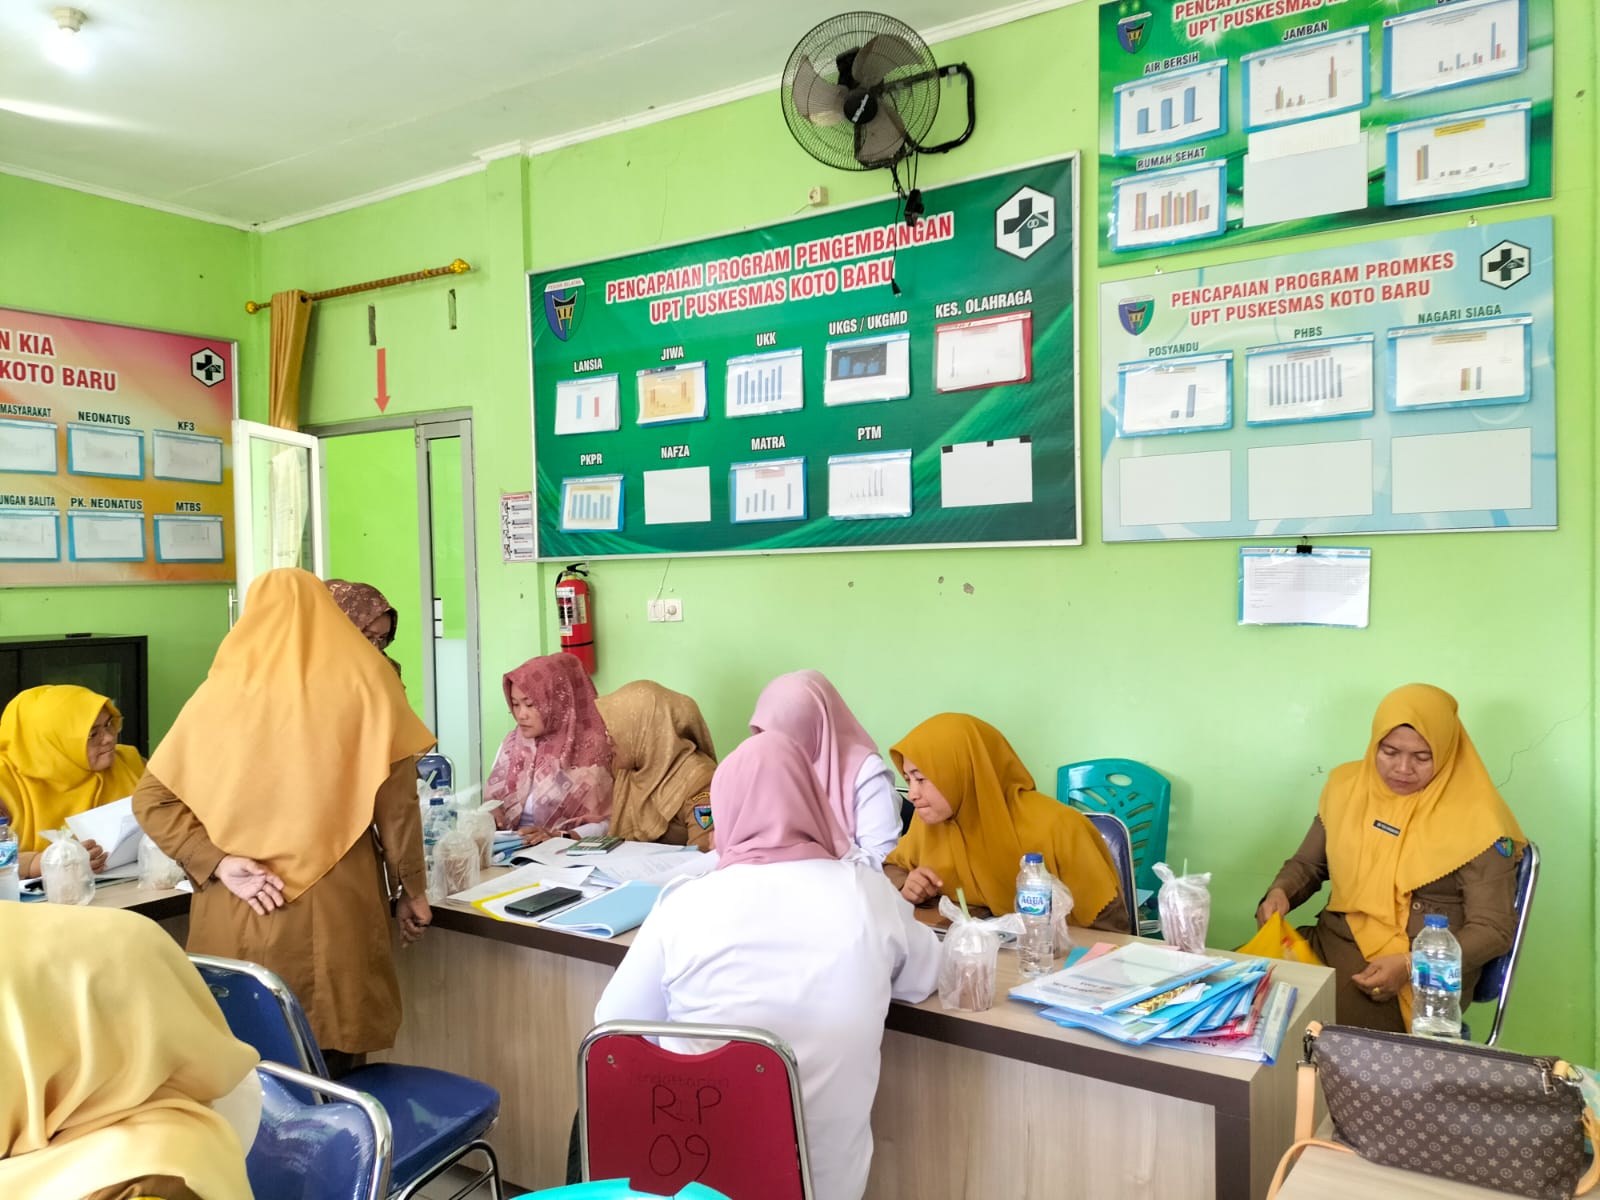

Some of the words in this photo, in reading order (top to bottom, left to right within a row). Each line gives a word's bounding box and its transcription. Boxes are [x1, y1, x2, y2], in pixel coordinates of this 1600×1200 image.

[1189, 17, 1217, 38] UPT
[1283, 21, 1328, 41] JAMBAN
[1144, 61, 1161, 74] AIR
[1163, 53, 1199, 70] BERSIH
[1137, 154, 1173, 170] RUMAH
[1175, 147, 1206, 162] SEHAT
[607, 266, 702, 303] PENCAPAIAN
[707, 248, 790, 284] PROGRAM
[796, 214, 954, 267] PENGEMBANGAN
[1171, 279, 1269, 308] PENCAPAIAN
[1275, 266, 1359, 293] PROGRAM
[1365, 252, 1455, 280] PROMKES
[651, 299, 682, 323] UPT
[685, 280, 786, 317] PUSKESMAS
[791, 270, 837, 299] KOTO
[843, 258, 894, 289] BARU
[935, 304, 962, 319] KES.
[965, 289, 1033, 313] OLAHRAGA
[1191, 308, 1221, 326] UPT
[1226, 294, 1324, 321] PUSKESMAS
[1330, 287, 1375, 307] KOTO
[1381, 279, 1430, 301] BARU
[1418, 309, 1462, 324] NAGARI
[1465, 304, 1502, 318] SIAGA
[828, 318, 857, 335] UKGS
[859, 316, 865, 332] /
[867, 310, 908, 329] UKGMD
[756, 331, 777, 347] UKK
[1294, 326, 1323, 339] PHBS
[19, 333, 54, 356] KIA
[1148, 341, 1199, 357] POSYANDU
[661, 346, 684, 361] JIWA
[573, 358, 603, 373] LANSIA
[0, 360, 54, 384] KOTO
[62, 367, 116, 391] BARU
[78, 411, 131, 425] NEONATUS
[177, 421, 195, 432] KF3
[857, 426, 882, 441] PTM
[751, 436, 785, 451] MATRA
[580, 453, 603, 466] PKPR
[660, 445, 690, 459] NAFZA
[28, 496, 56, 507] BALITA
[70, 497, 87, 508] PK.
[90, 498, 143, 510] NEONATUS
[176, 502, 201, 512] MTBS
[1021, 895, 1044, 906] AQUA
[648, 1134, 711, 1182] 09
